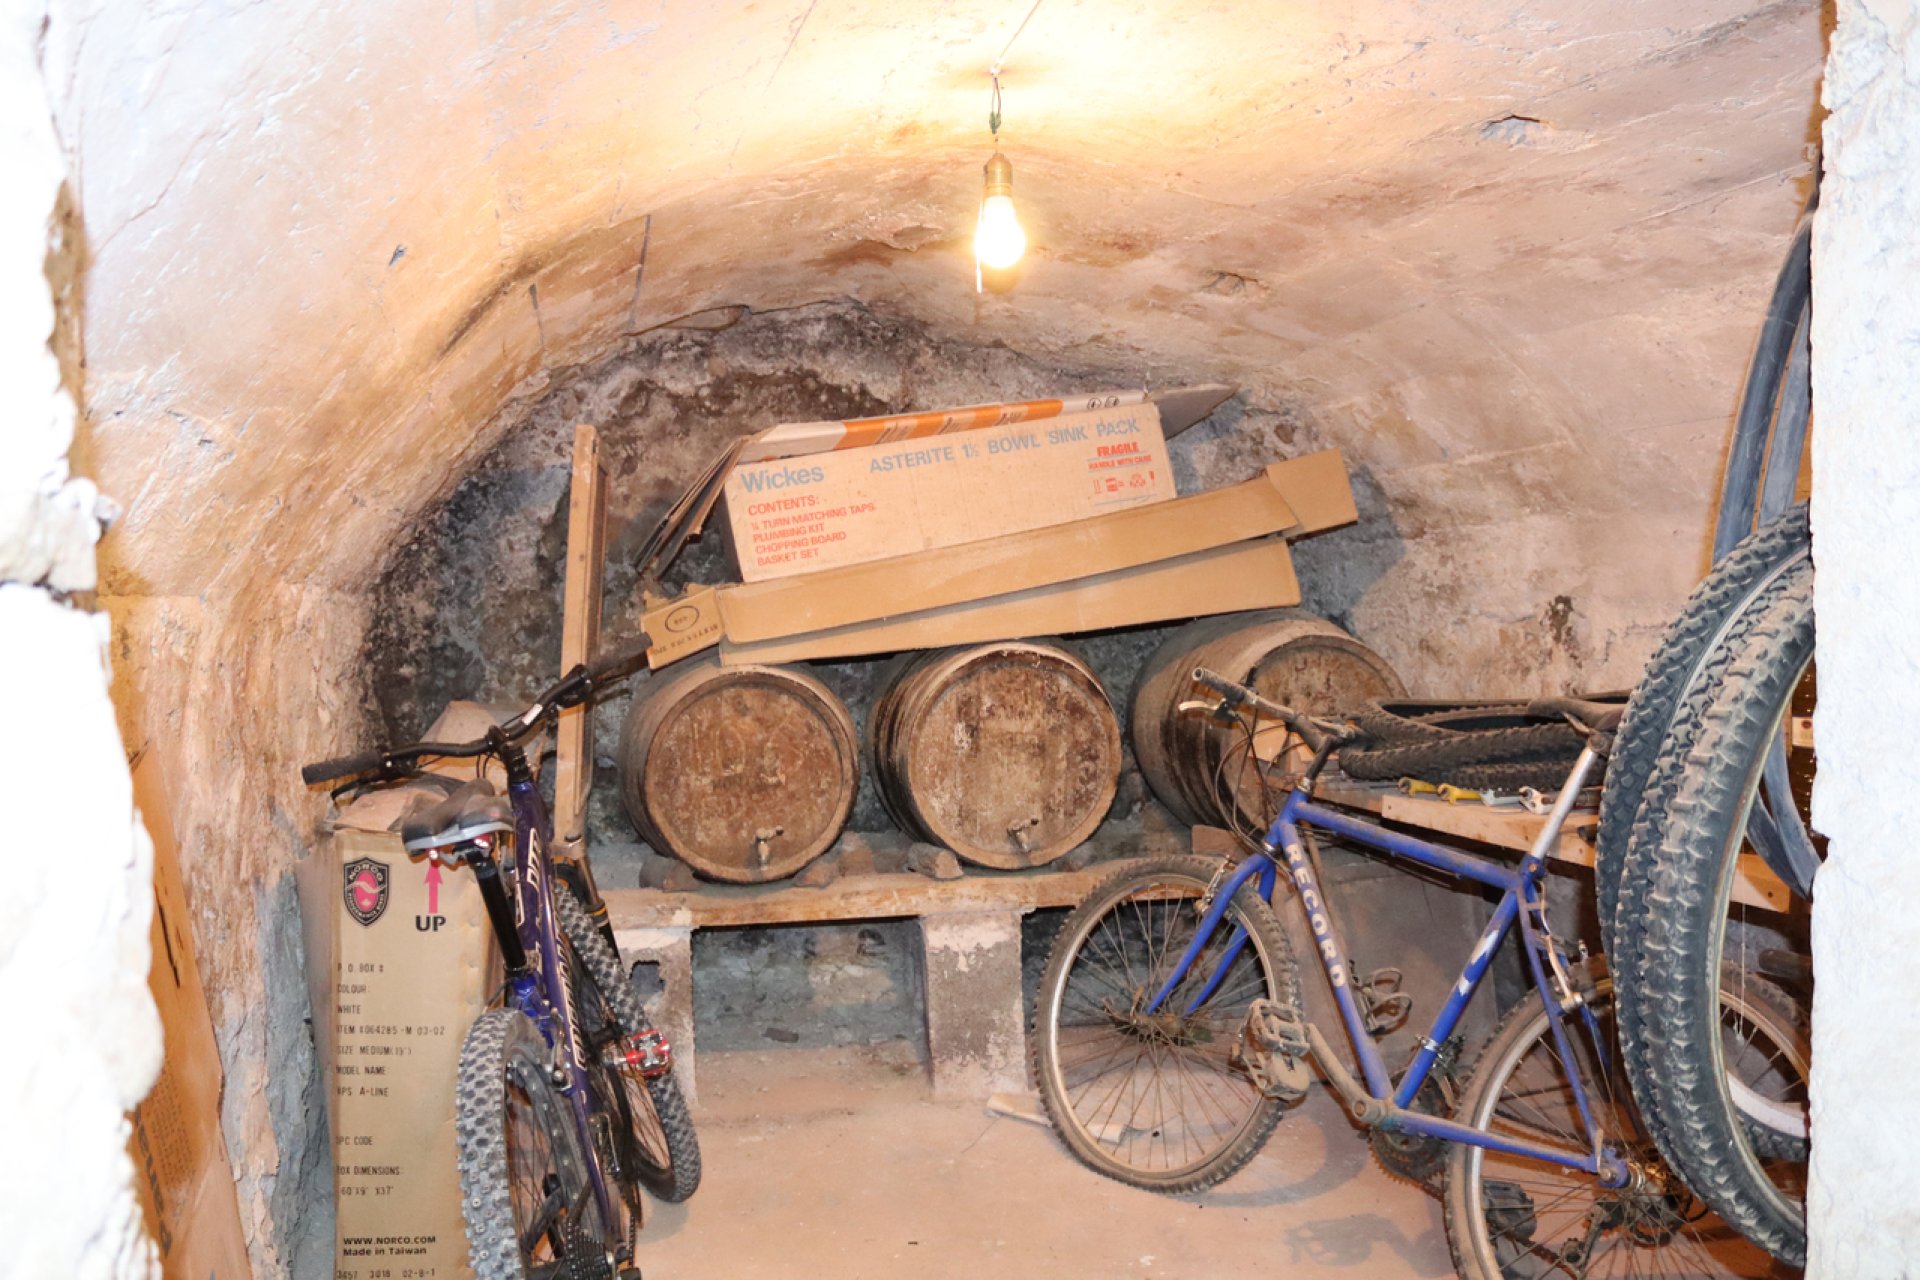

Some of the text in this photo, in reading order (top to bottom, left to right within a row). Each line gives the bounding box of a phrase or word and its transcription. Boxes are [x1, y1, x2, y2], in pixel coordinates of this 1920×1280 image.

[869, 446, 955, 474] ASTERITE
[988, 431, 1041, 454] BOWL
[1048, 425, 1088, 445] SINK
[1096, 417, 1140, 437] PACK
[1096, 441, 1140, 457] FRAGILE
[740, 466, 825, 493] Wickes
[748, 495, 820, 516] CONTENTS:
[763, 517, 790, 530] TURN
[791, 507, 848, 524] MATCHING
[850, 502, 877, 516] TAPS
[753, 522, 825, 543] PLUMBING KIT
[755, 531, 847, 555] CHOPPING BOARD
[757, 548, 820, 567] BASKET SET
[349, 863, 384, 881] NORCO
[415, 914, 446, 932] UP
[1286, 844, 1346, 987] RECORD
[359, 1087, 389, 1097] A-LINE
[343, 1236, 437, 1245] WWW.NORCO.COM
[343, 1247, 427, 1256] Made in Taiwan
